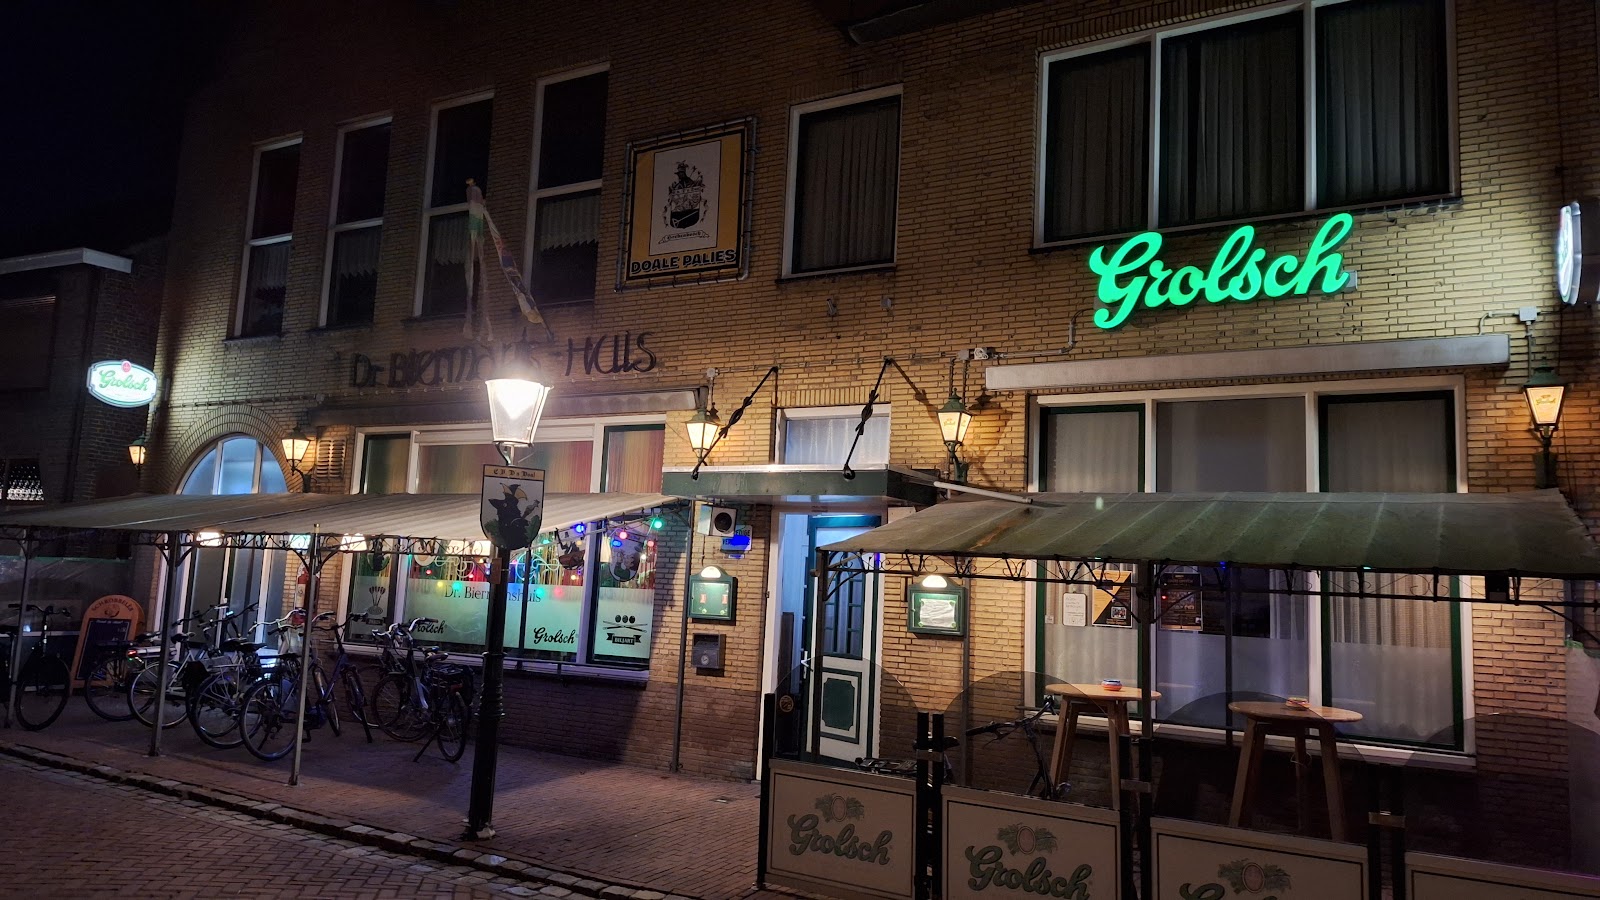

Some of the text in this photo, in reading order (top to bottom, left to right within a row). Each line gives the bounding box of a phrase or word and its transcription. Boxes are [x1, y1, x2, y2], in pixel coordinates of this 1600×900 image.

[631, 250, 737, 274] DOALE PALIES
[1088, 212, 1354, 329] Grolsch
[98, 369, 151, 391] Grolsch
[414, 619, 446, 635] rolsch
[533, 626, 577, 645] Grolsch
[787, 813, 894, 866] Grolsch
[965, 845, 1093, 900] Grolsch
